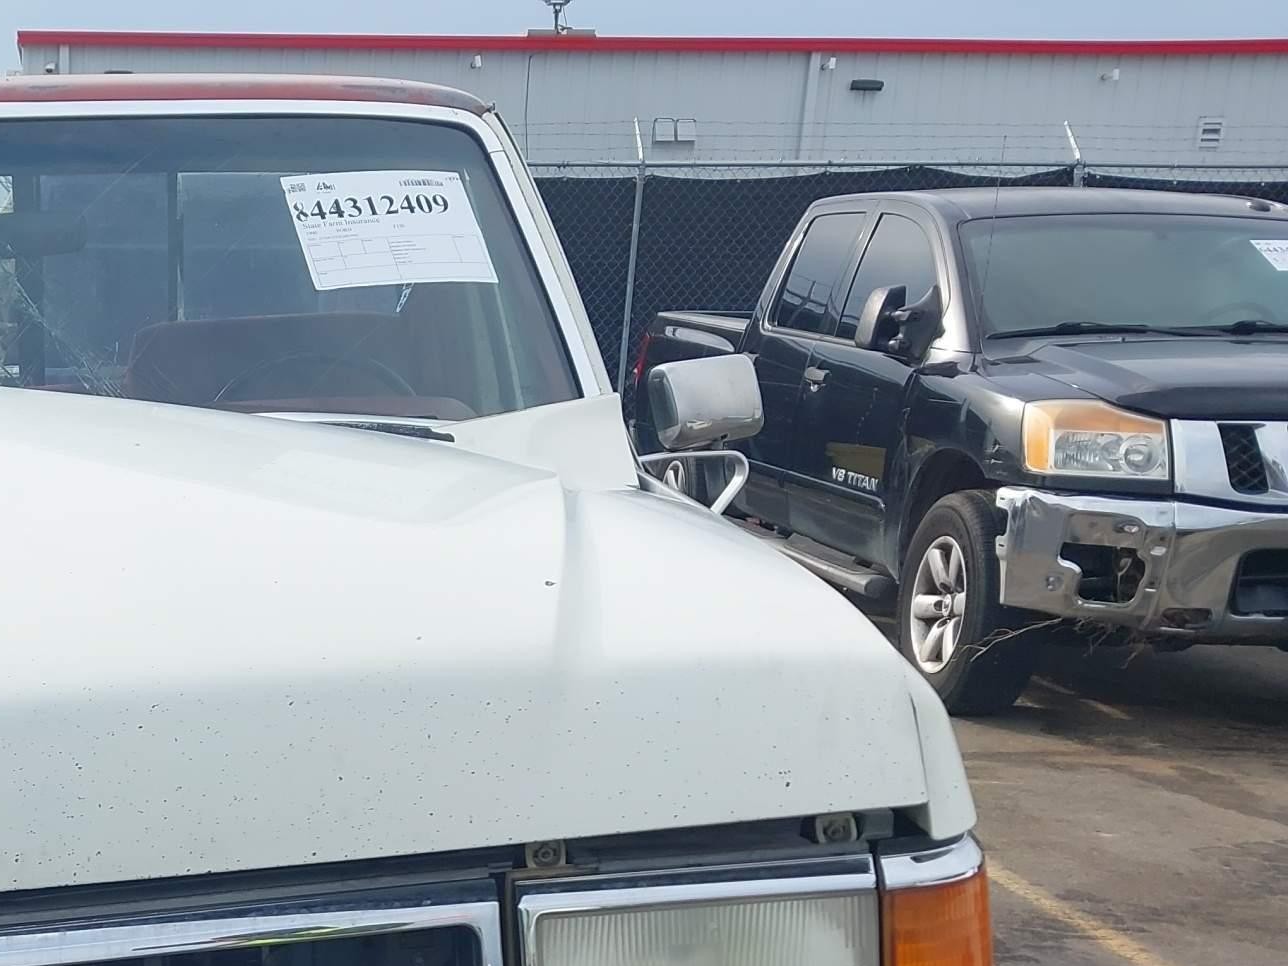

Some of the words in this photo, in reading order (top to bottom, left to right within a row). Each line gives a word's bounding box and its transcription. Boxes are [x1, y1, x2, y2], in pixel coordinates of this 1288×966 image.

[293, 194, 449, 222] 844312409
[323, 220, 343, 228] Farm
[832, 467, 845, 481] V8
[847, 471, 879, 491] TITAN
